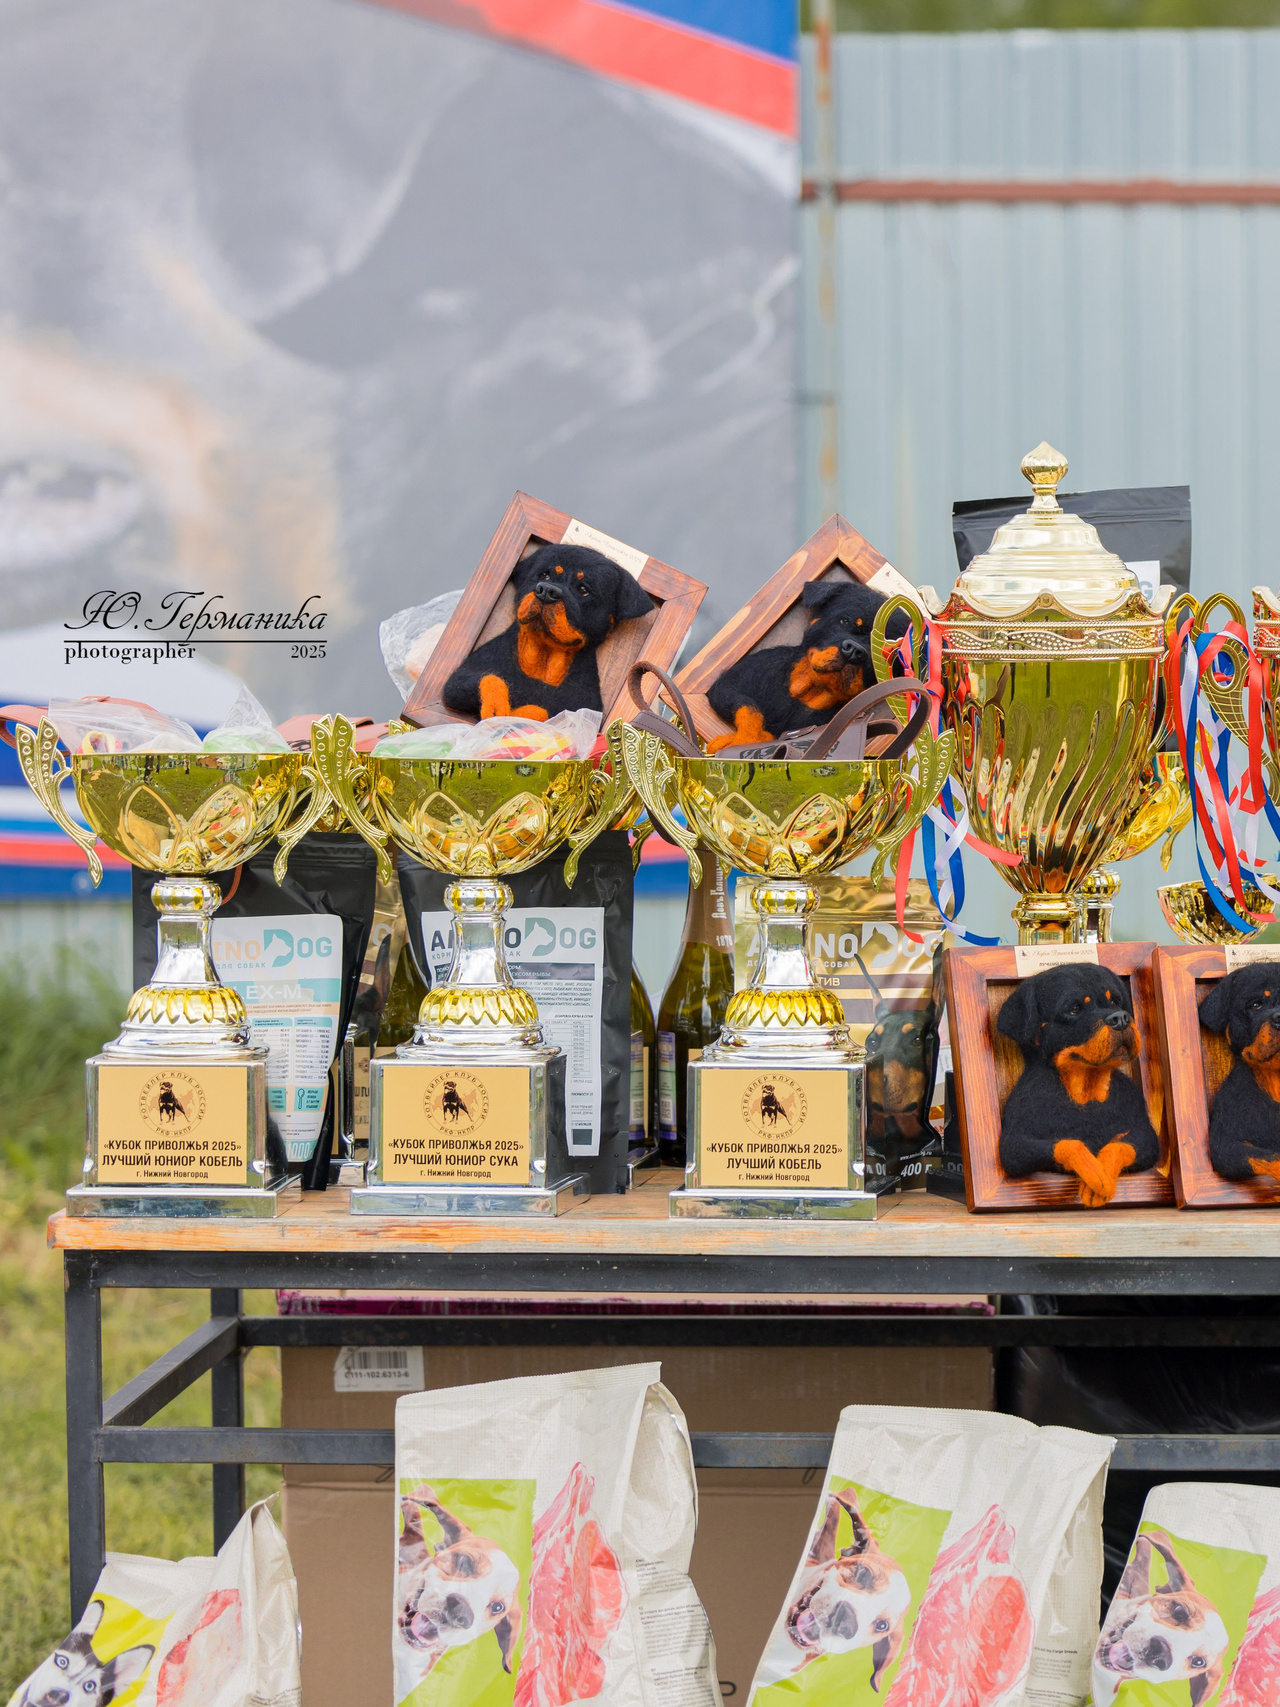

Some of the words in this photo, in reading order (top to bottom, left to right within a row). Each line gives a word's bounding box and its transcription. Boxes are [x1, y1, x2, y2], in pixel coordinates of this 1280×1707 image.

[170, 1072, 193, 1083] КЛУБ
[454, 1071, 476, 1082] КЛУБ
[772, 1075, 795, 1086] КЛУБ
[104, 1140, 141, 1150] «КУБОК
[145, 1140, 208, 1150] ПРИВОЛЖЬЯ
[212, 1141, 241, 1151] 2025»
[388, 1139, 425, 1149] «КУБОК
[429, 1139, 491, 1150] ПРИВОЛЖЬЯ
[495, 1141, 523, 1150] 2025»
[707, 1143, 743, 1152] «КУБОК
[747, 1143, 810, 1153] ПРИВОЛЖЬЯ
[813, 1144, 842, 1154] 2025»
[102, 1153, 151, 1166] ЛУЧШИЙ
[154, 1155, 195, 1166] ЮНИОР
[199, 1156, 243, 1167] КОБЕЛЬ
[393, 1152, 441, 1165] ЛУЧШИЙ
[445, 1155, 486, 1166] ЮНИОР
[489, 1155, 518, 1166] СУКА
[727, 1156, 775, 1169] ЛУЧШИЙ
[779, 1159, 821, 1170] КОБЕЛЬ
[144, 1170, 171, 1178] Нижний
[173, 1171, 208, 1179] Новгород
[427, 1169, 455, 1177] Нижний
[457, 1170, 491, 1178] Новгород
[900, 1162, 922, 1177] 400
[775, 1173, 810, 1182] Новгород
